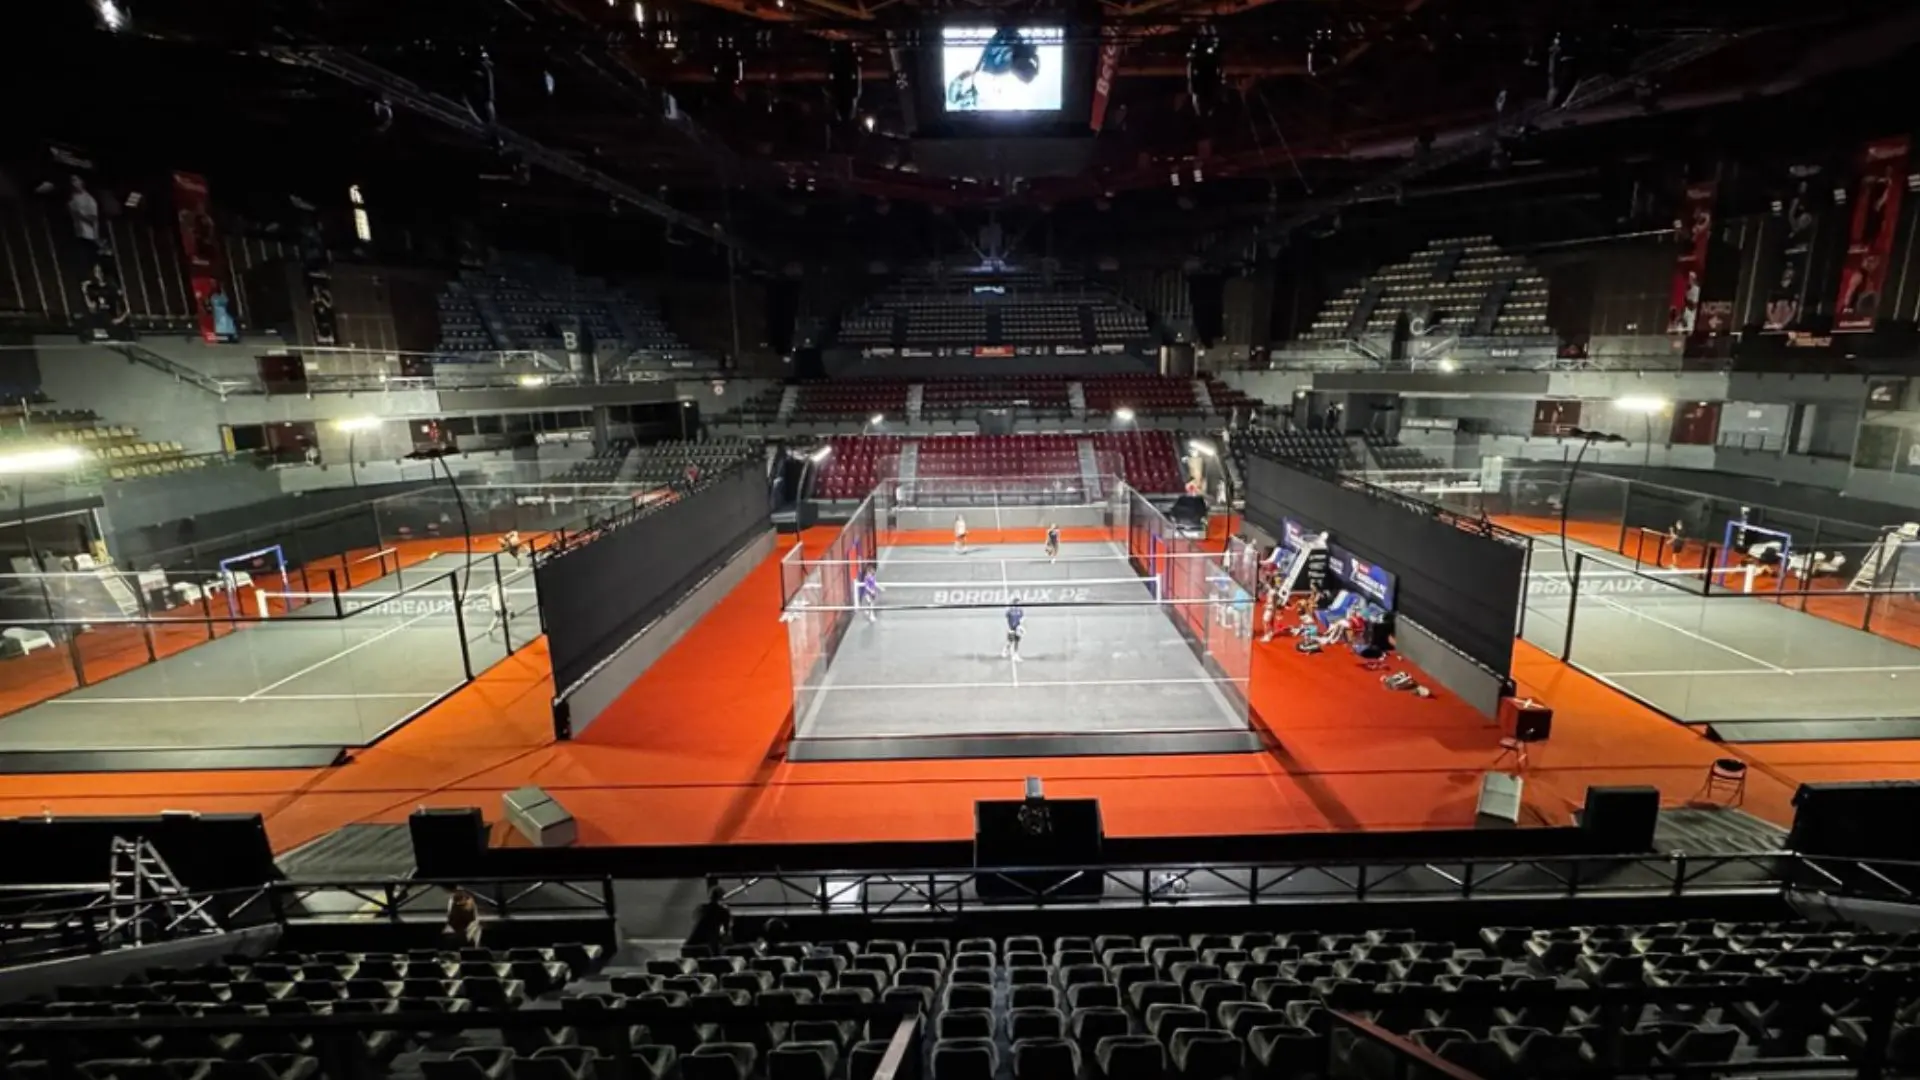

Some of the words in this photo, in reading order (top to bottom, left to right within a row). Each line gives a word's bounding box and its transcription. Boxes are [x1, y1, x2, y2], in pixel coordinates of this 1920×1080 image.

[1410, 317, 1424, 336] C
[563, 331, 578, 350] B
[933, 588, 1053, 604] BORDEAUX
[1059, 587, 1091, 602] P2
